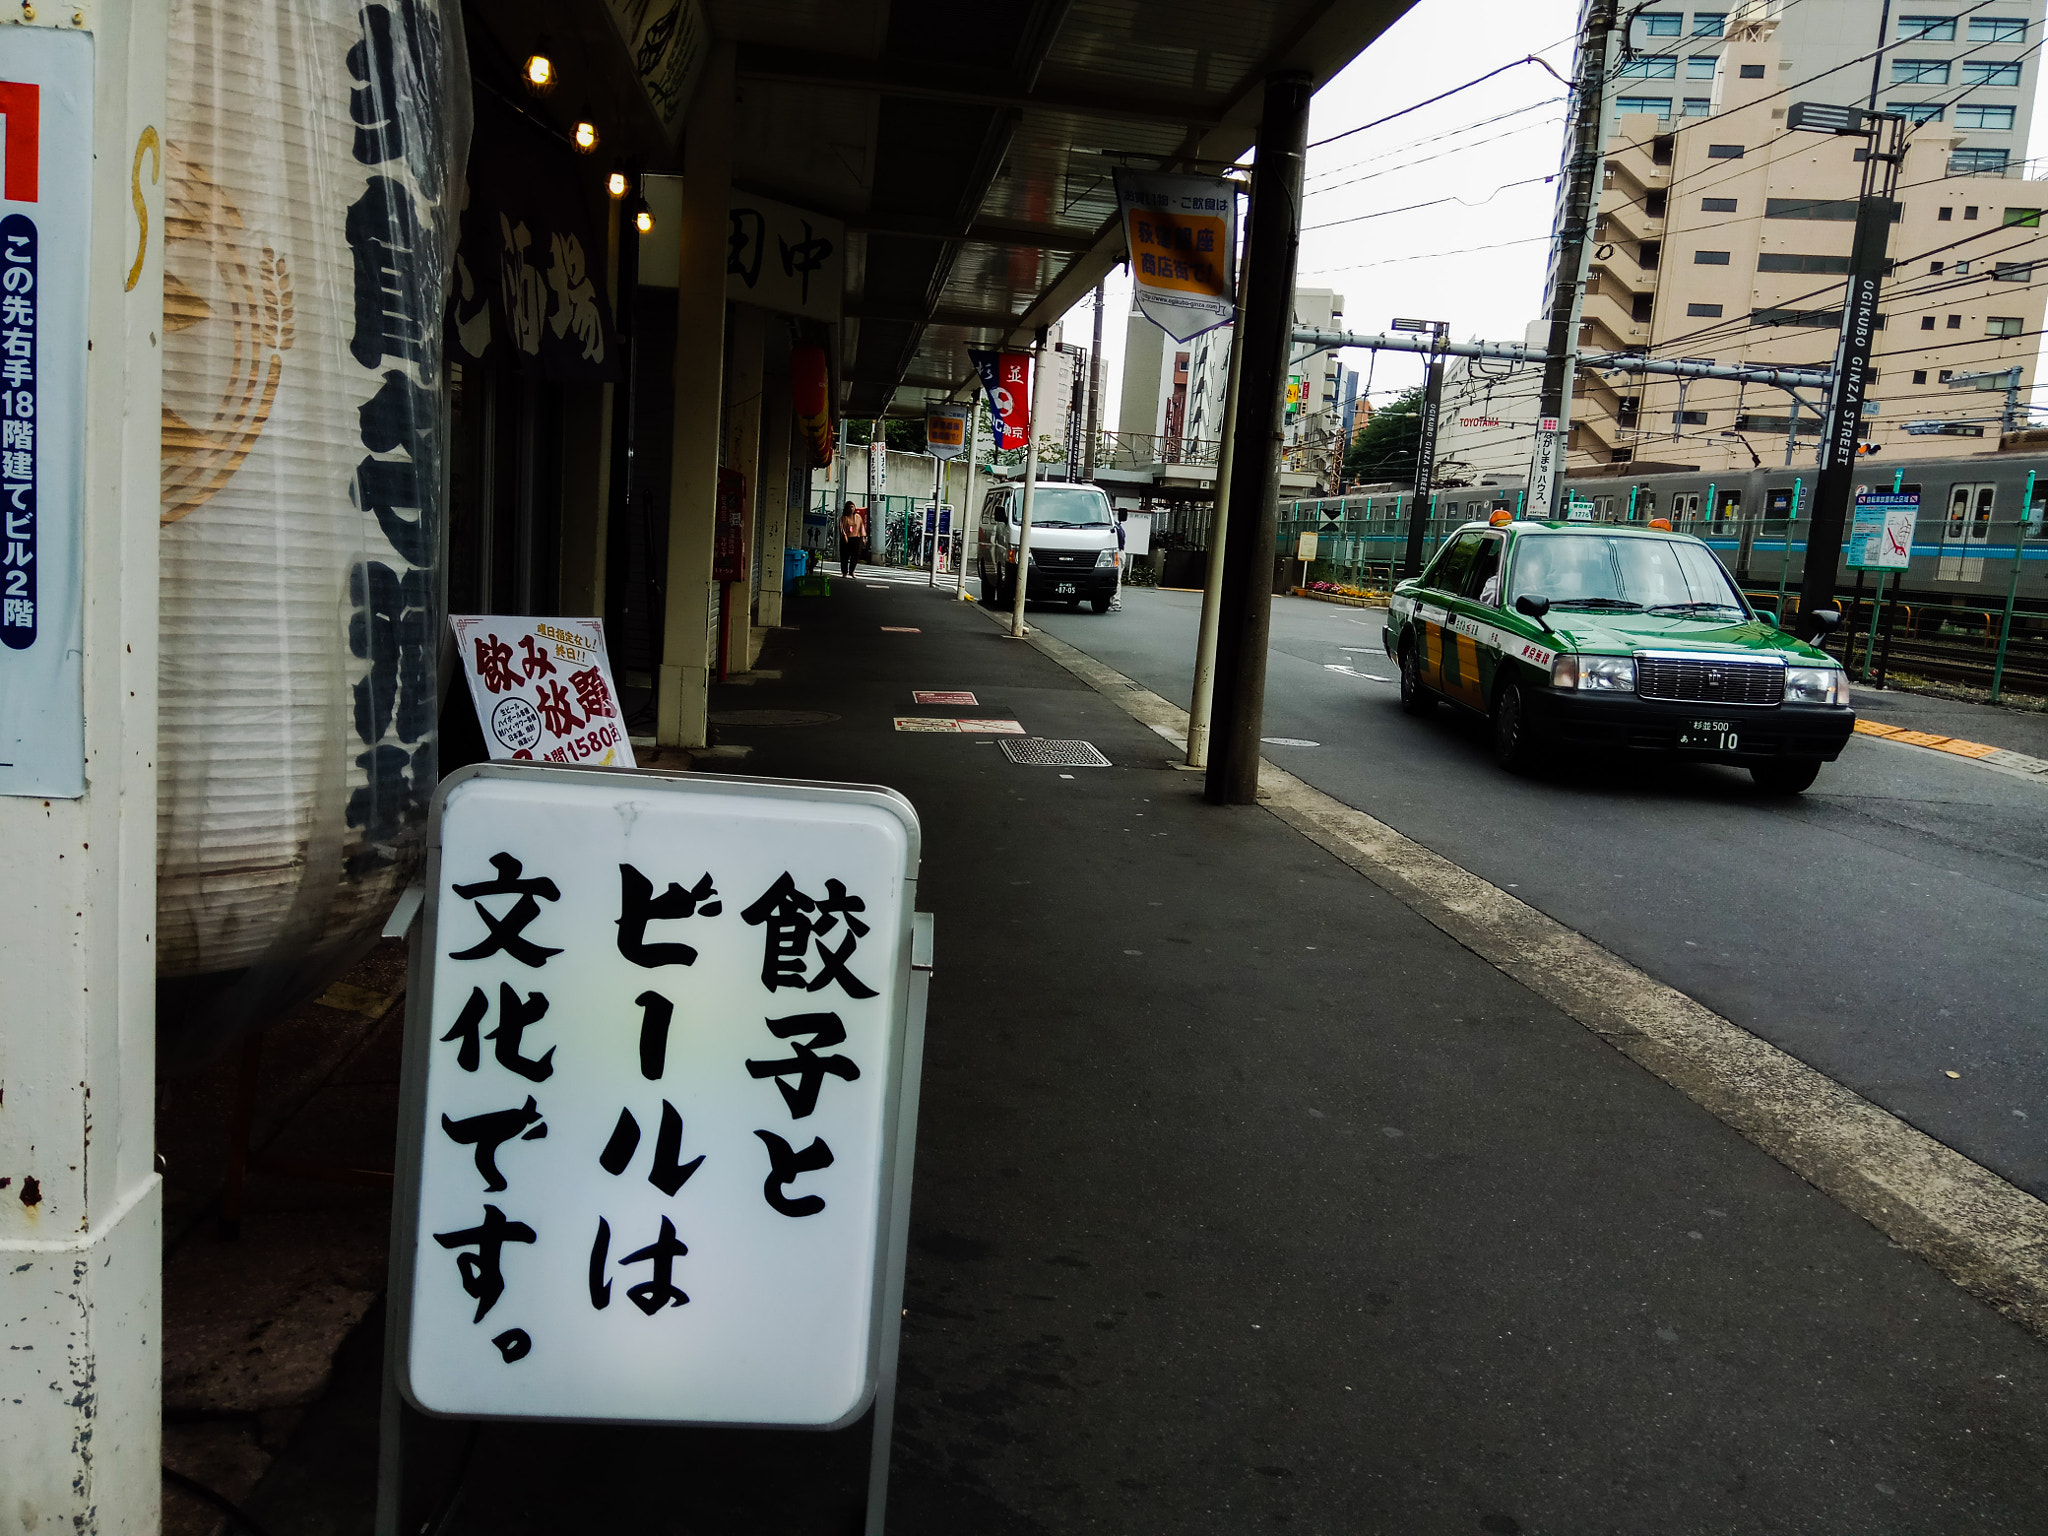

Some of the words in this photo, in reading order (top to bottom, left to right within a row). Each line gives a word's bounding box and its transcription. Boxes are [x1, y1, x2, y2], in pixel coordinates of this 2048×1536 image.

[1854, 280, 1875, 347] OGIKUBO
[1846, 356, 1863, 403] GINZA
[2, 235, 34, 629] この先右手18階建てビル2階
[1426, 403, 1437, 437] OGIKUBO
[1837, 410, 1855, 466] STREET
[1420, 468, 1429, 496] STREET
[1423, 441, 1432, 465] GINZA
[474, 633, 557, 694] 飲み
[536, 623, 598, 650] 曜日指定なし!
[535, 665, 618, 739] 放題
[1693, 721, 1711, 730] 杉並
[1712, 722, 1729, 731] 500
[741, 871, 880, 1217] 餃子と
[432, 851, 564, 1364] 文化です。
[589, 863, 722, 1316] ビールは
